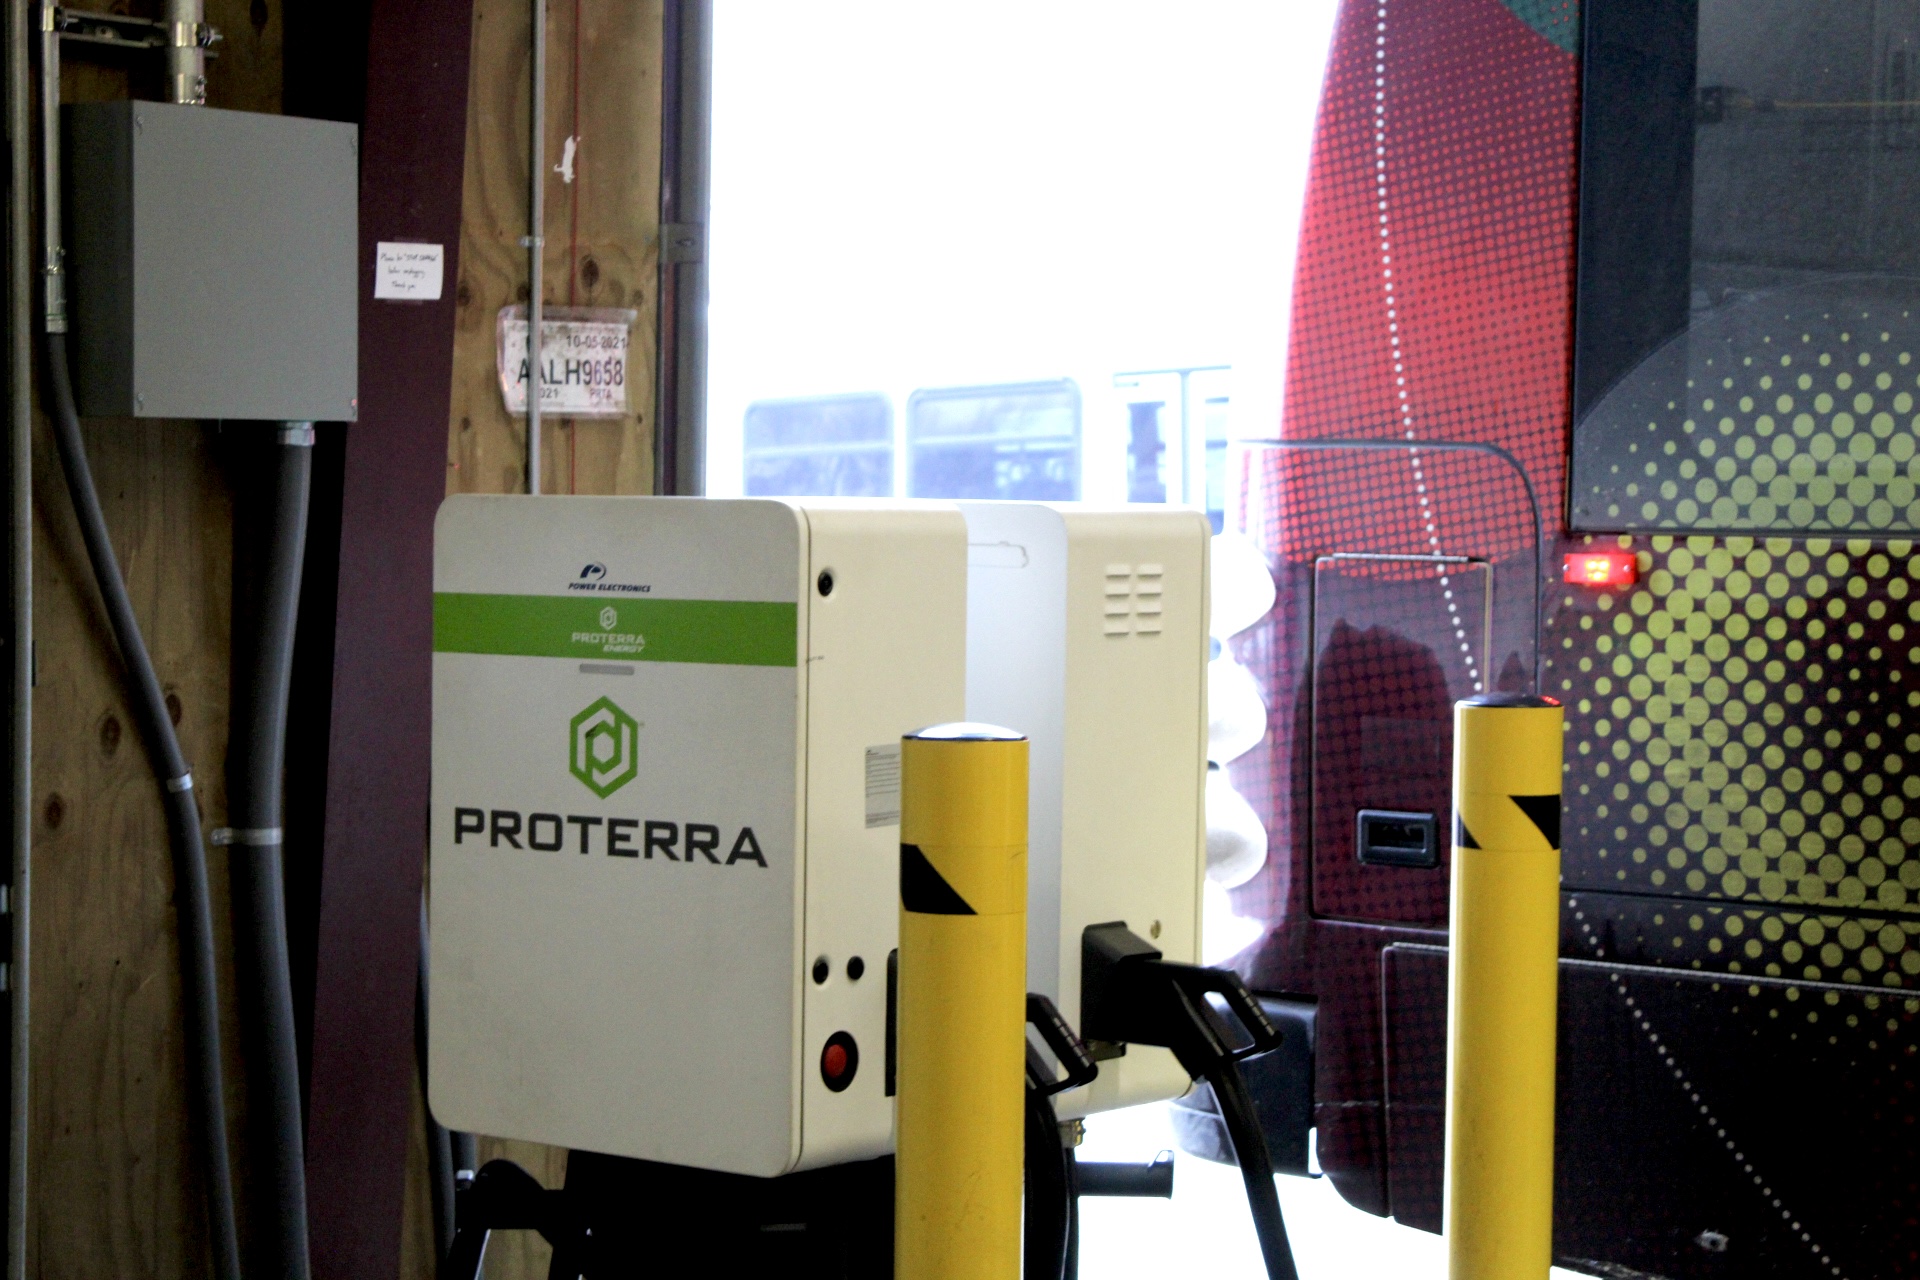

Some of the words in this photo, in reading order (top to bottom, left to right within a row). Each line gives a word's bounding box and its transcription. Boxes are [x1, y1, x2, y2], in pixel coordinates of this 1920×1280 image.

[568, 582, 597, 591] POWER
[598, 583, 652, 593] ELECTRONICS
[571, 632, 646, 646] PROTERRA
[603, 644, 645, 653] ENERGY
[454, 807, 768, 868] PROTERRA
